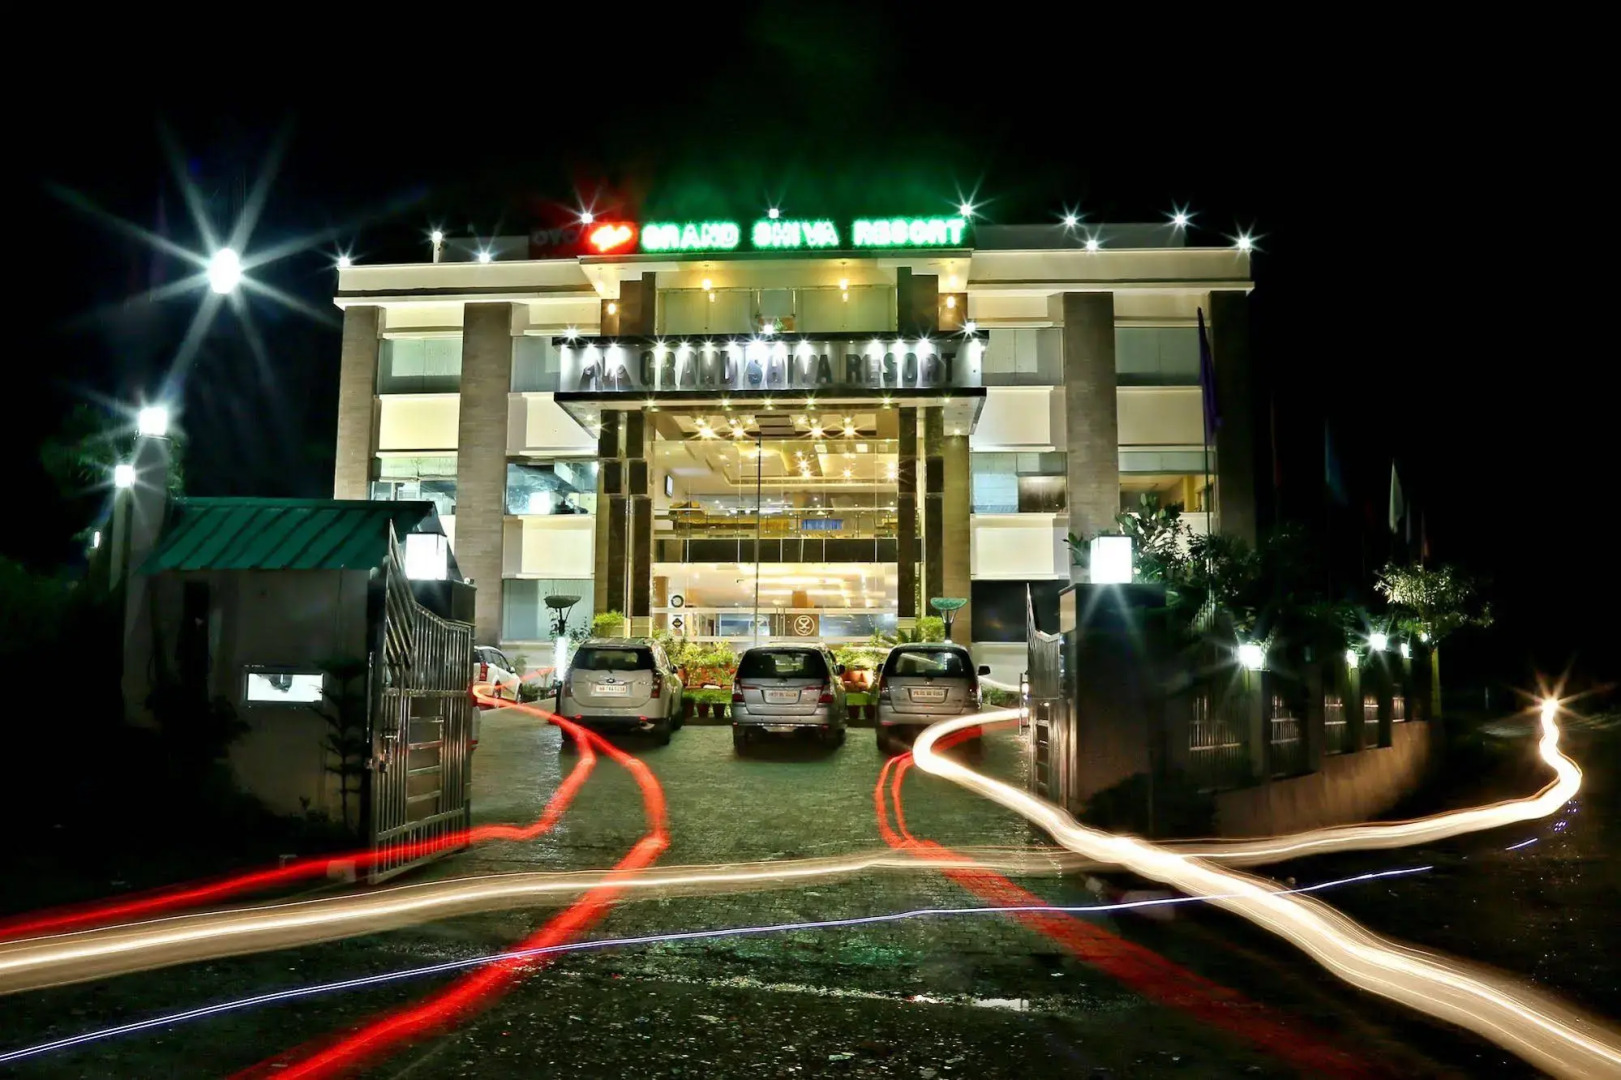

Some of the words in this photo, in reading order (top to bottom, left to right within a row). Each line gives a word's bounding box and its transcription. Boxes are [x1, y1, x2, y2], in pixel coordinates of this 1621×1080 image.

[641, 222, 740, 250] GRAND
[752, 219, 838, 248] SHIVA
[853, 217, 966, 246] RESORT
[640, 350, 739, 387] GRAND
[845, 352, 957, 386] RESORT
